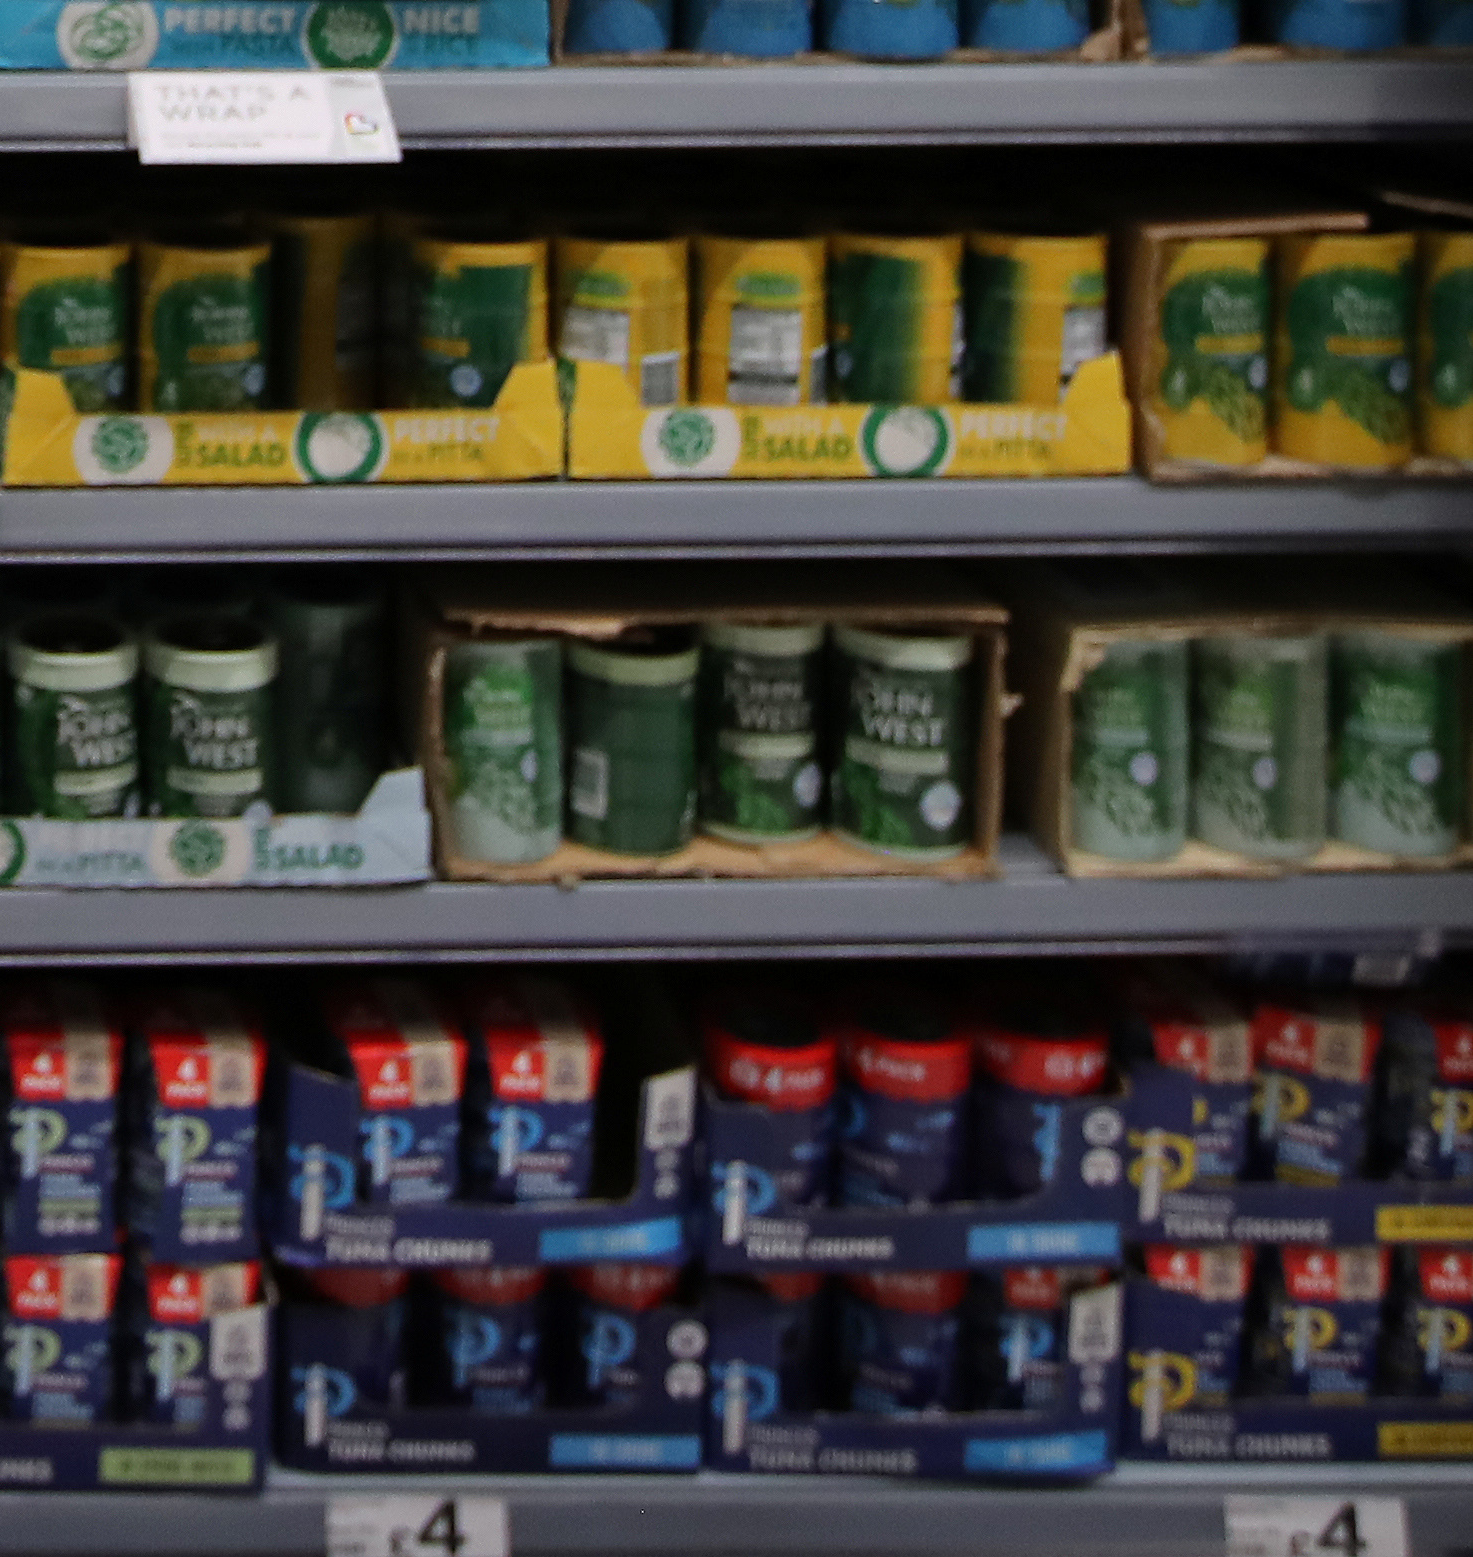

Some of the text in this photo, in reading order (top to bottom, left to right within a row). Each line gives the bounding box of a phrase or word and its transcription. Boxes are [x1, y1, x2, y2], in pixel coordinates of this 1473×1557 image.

[165, 7, 296, 33] PERFECT
[405, 7, 480, 34] NICE
[288, 85, 310, 101] A
[159, 105, 267, 122] WRAP
[195, 443, 287, 467] SALAD
[764, 438, 852, 462] SALAD
